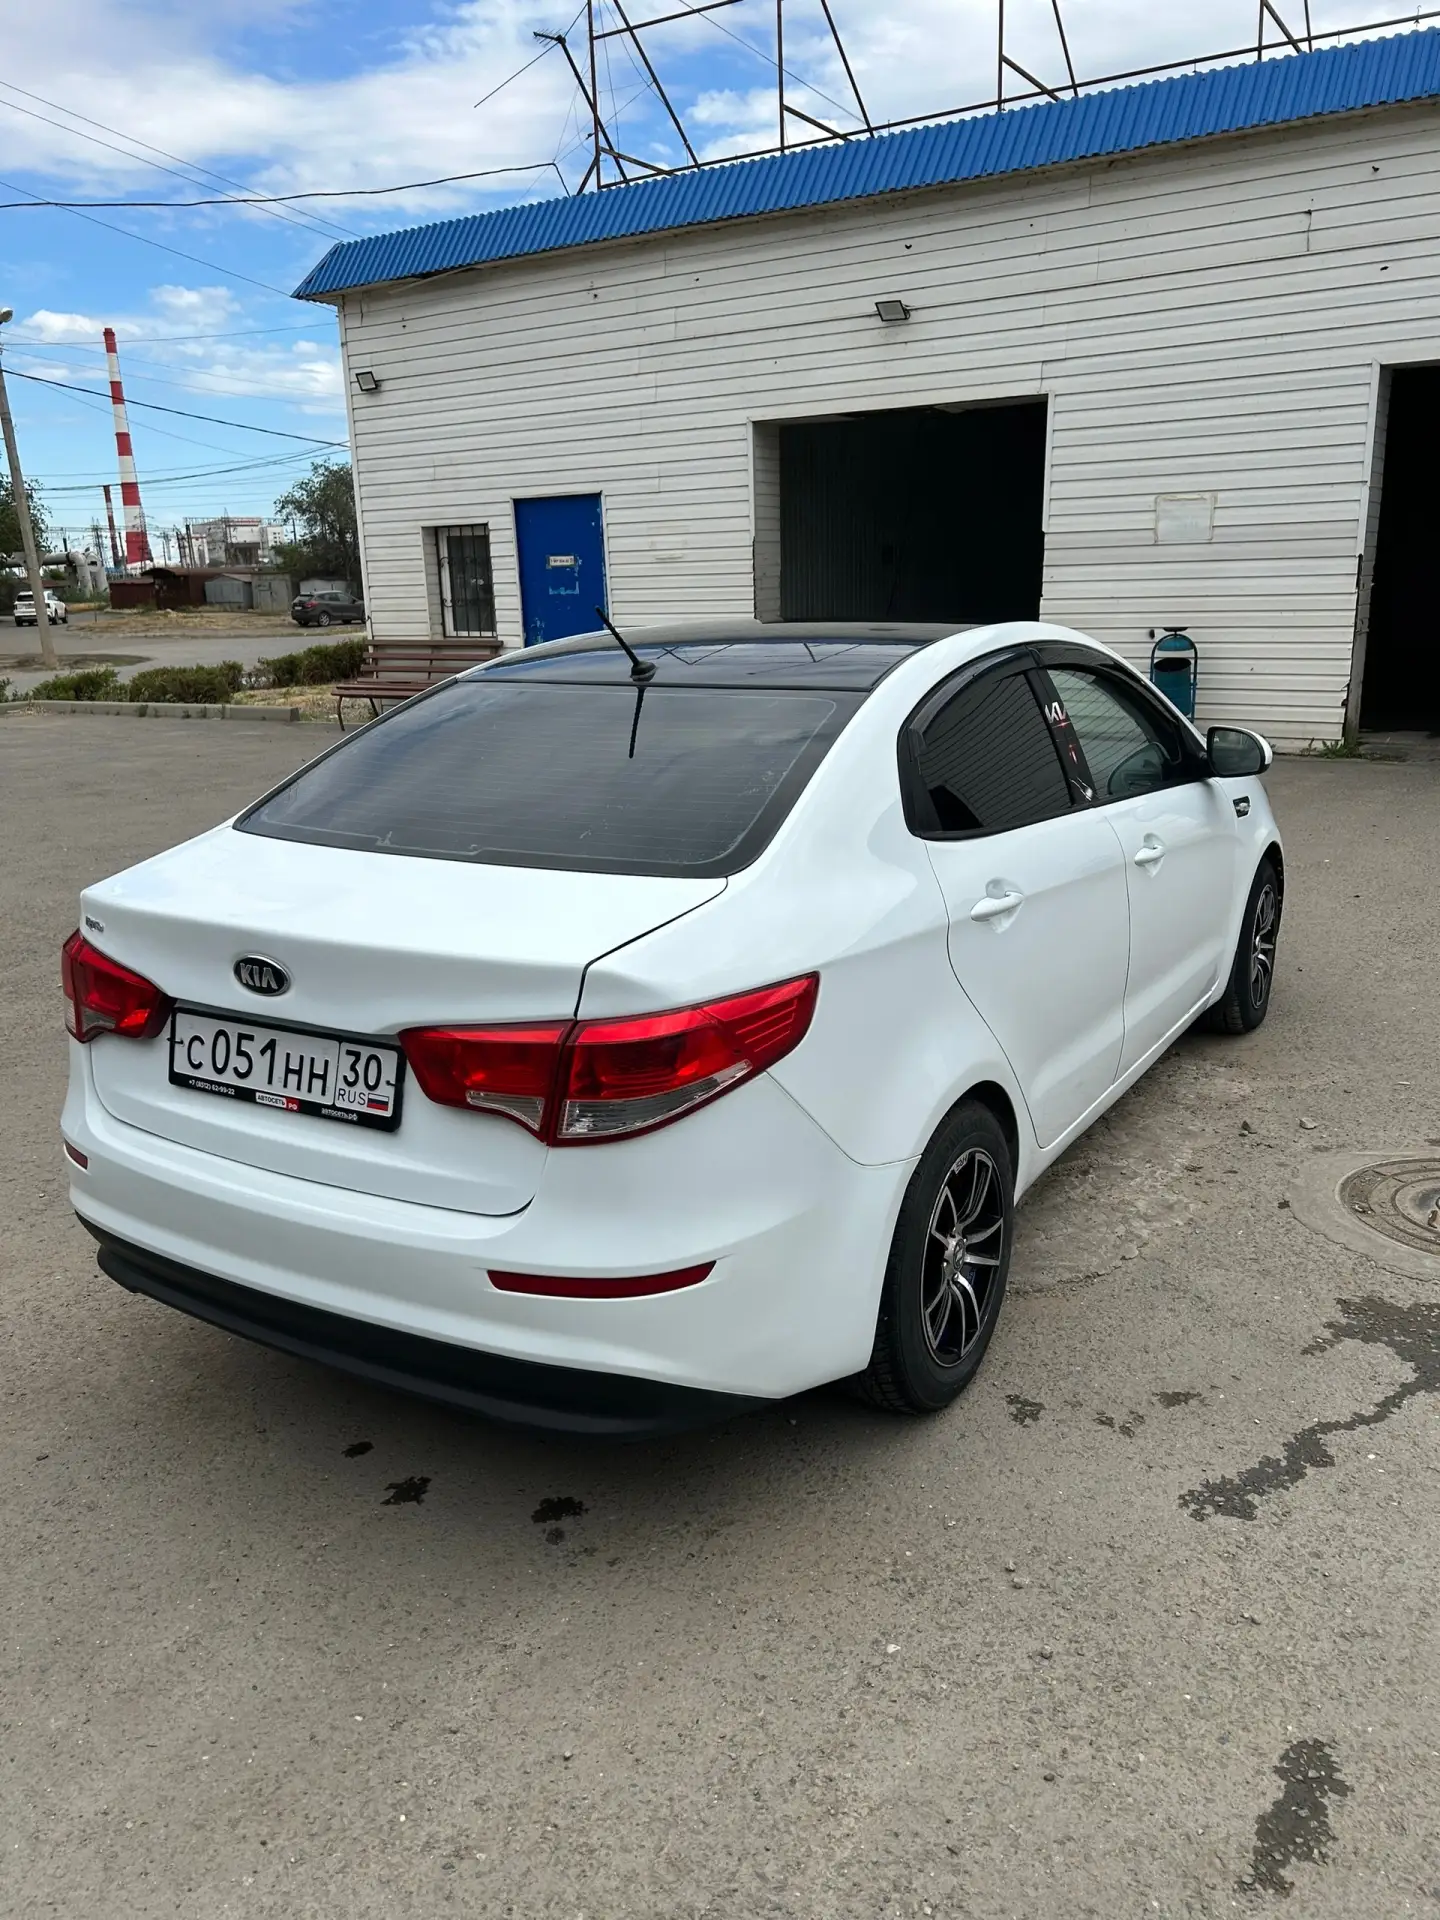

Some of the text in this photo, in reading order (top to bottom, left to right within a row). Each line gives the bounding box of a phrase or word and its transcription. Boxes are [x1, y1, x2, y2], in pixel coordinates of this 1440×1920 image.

[240, 962, 278, 990] KIA
[343, 1049, 382, 1091] 30
[258, 1095, 285, 1106] АВТОСЕТЬ
[337, 1088, 366, 1106] RUS
[321, 1107, 358, 1121] автосеть.рф
